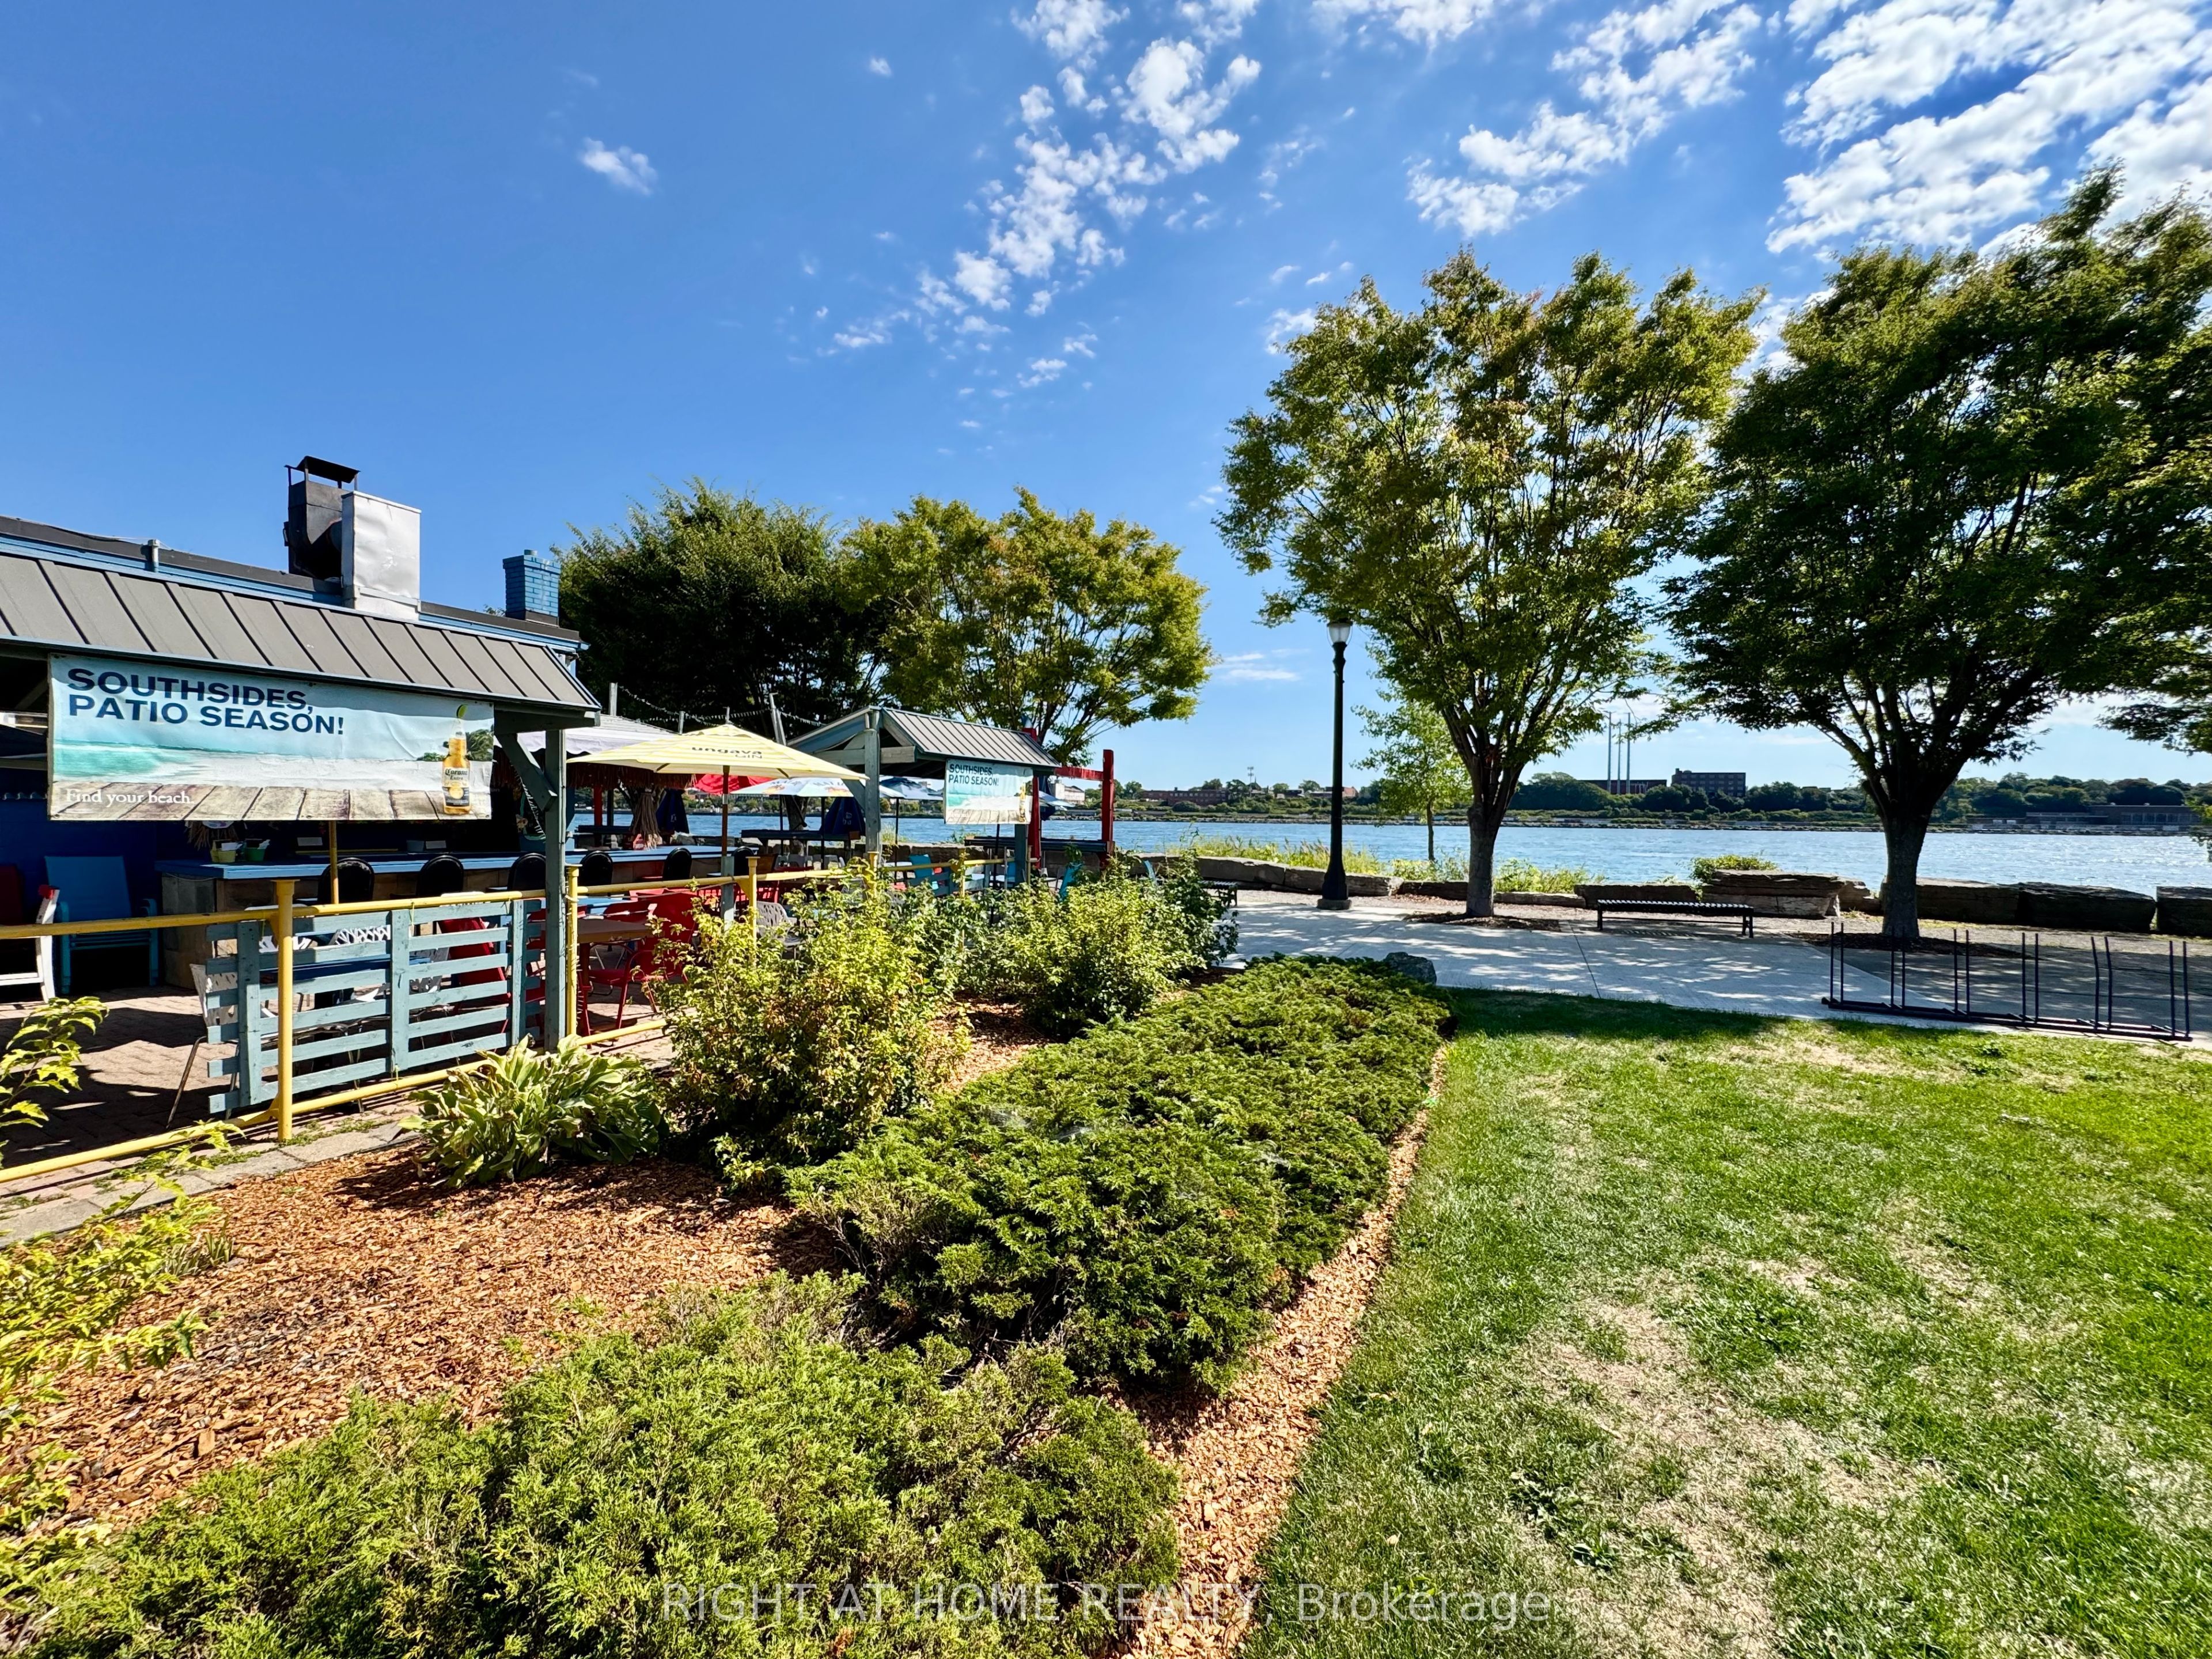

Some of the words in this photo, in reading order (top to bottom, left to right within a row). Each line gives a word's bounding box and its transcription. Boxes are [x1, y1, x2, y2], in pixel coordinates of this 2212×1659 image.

[67, 668, 313, 714] SOUTHSIDES,
[69, 694, 188, 724] PATIO
[199, 704, 344, 735] SEASON!
[949, 774, 969, 784] PATIO
[971, 776, 999, 786] SEASON!
[66, 788, 102, 803] Find
[106, 793, 144, 808] your
[148, 790, 194, 804] beach.
